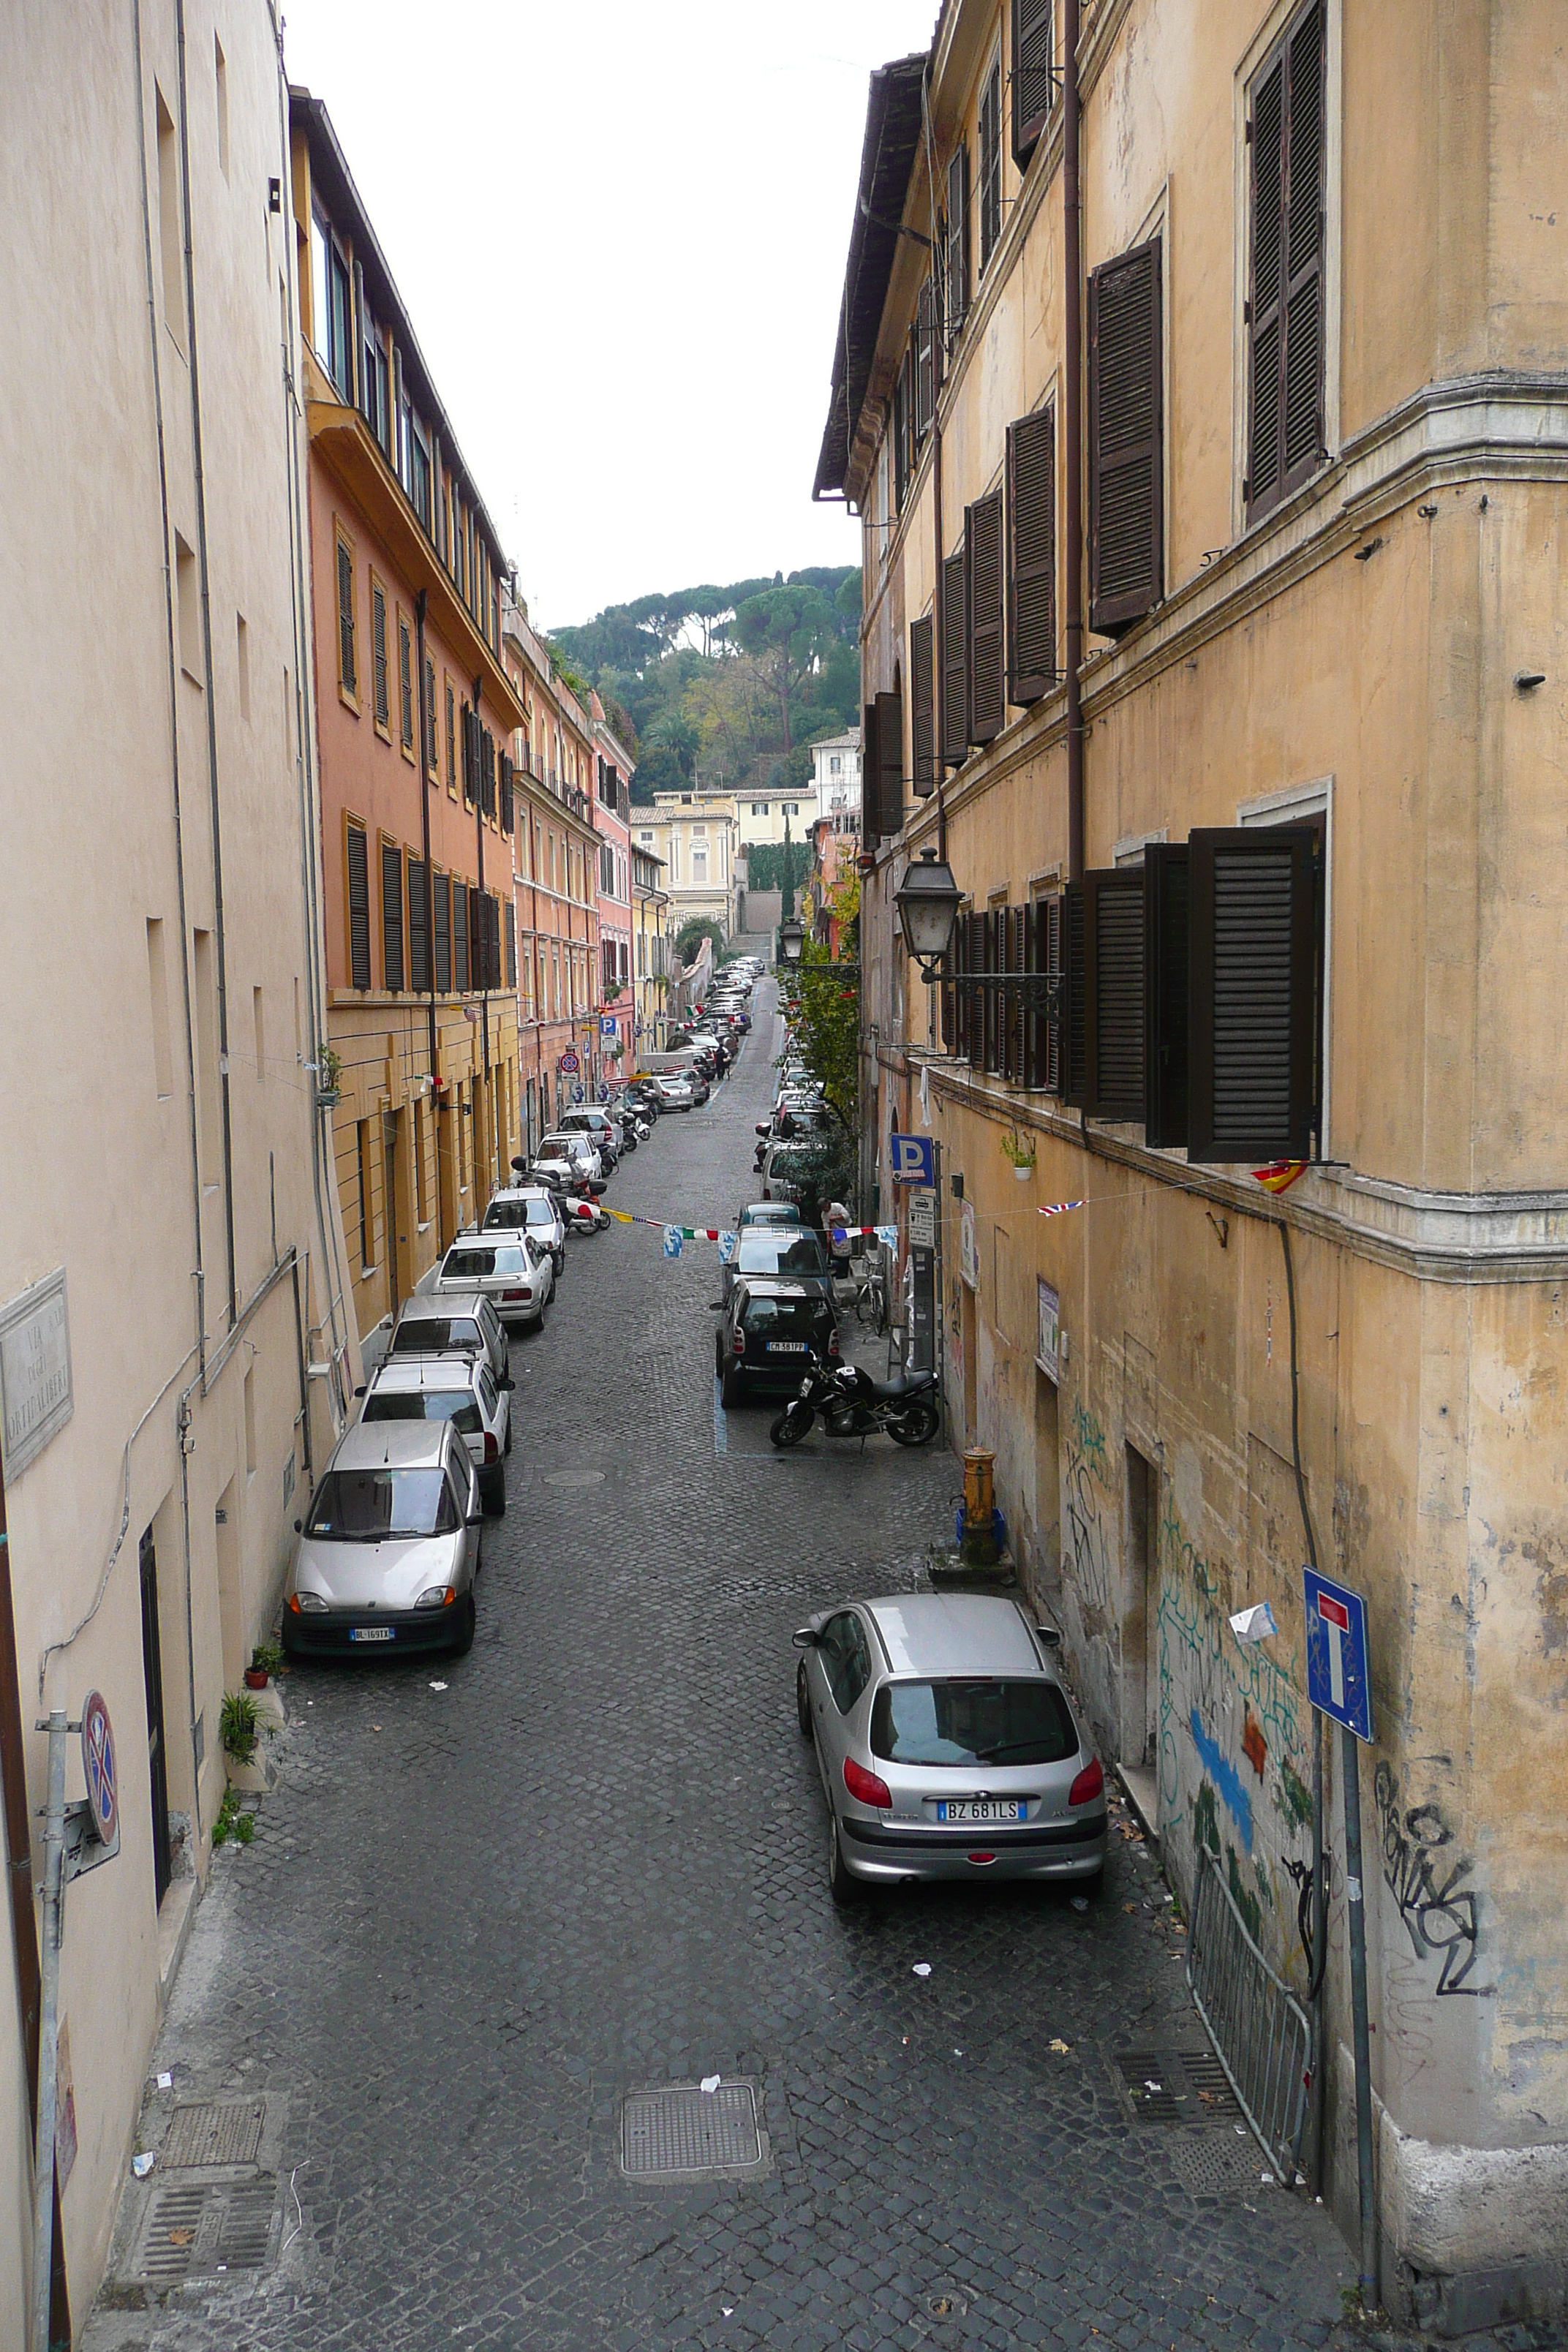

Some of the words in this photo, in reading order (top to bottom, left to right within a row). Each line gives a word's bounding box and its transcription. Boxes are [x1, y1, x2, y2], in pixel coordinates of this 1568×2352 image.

[603, 1019, 613, 1032] P
[899, 1139, 924, 1171] P
[27, 1326, 42, 1351] VIA
[355, 1630, 364, 1639] BL
[949, 1803, 966, 1819] BZ
[972, 1803, 1017, 1818] 681LS
[198, 2215, 219, 2248] SPQR
